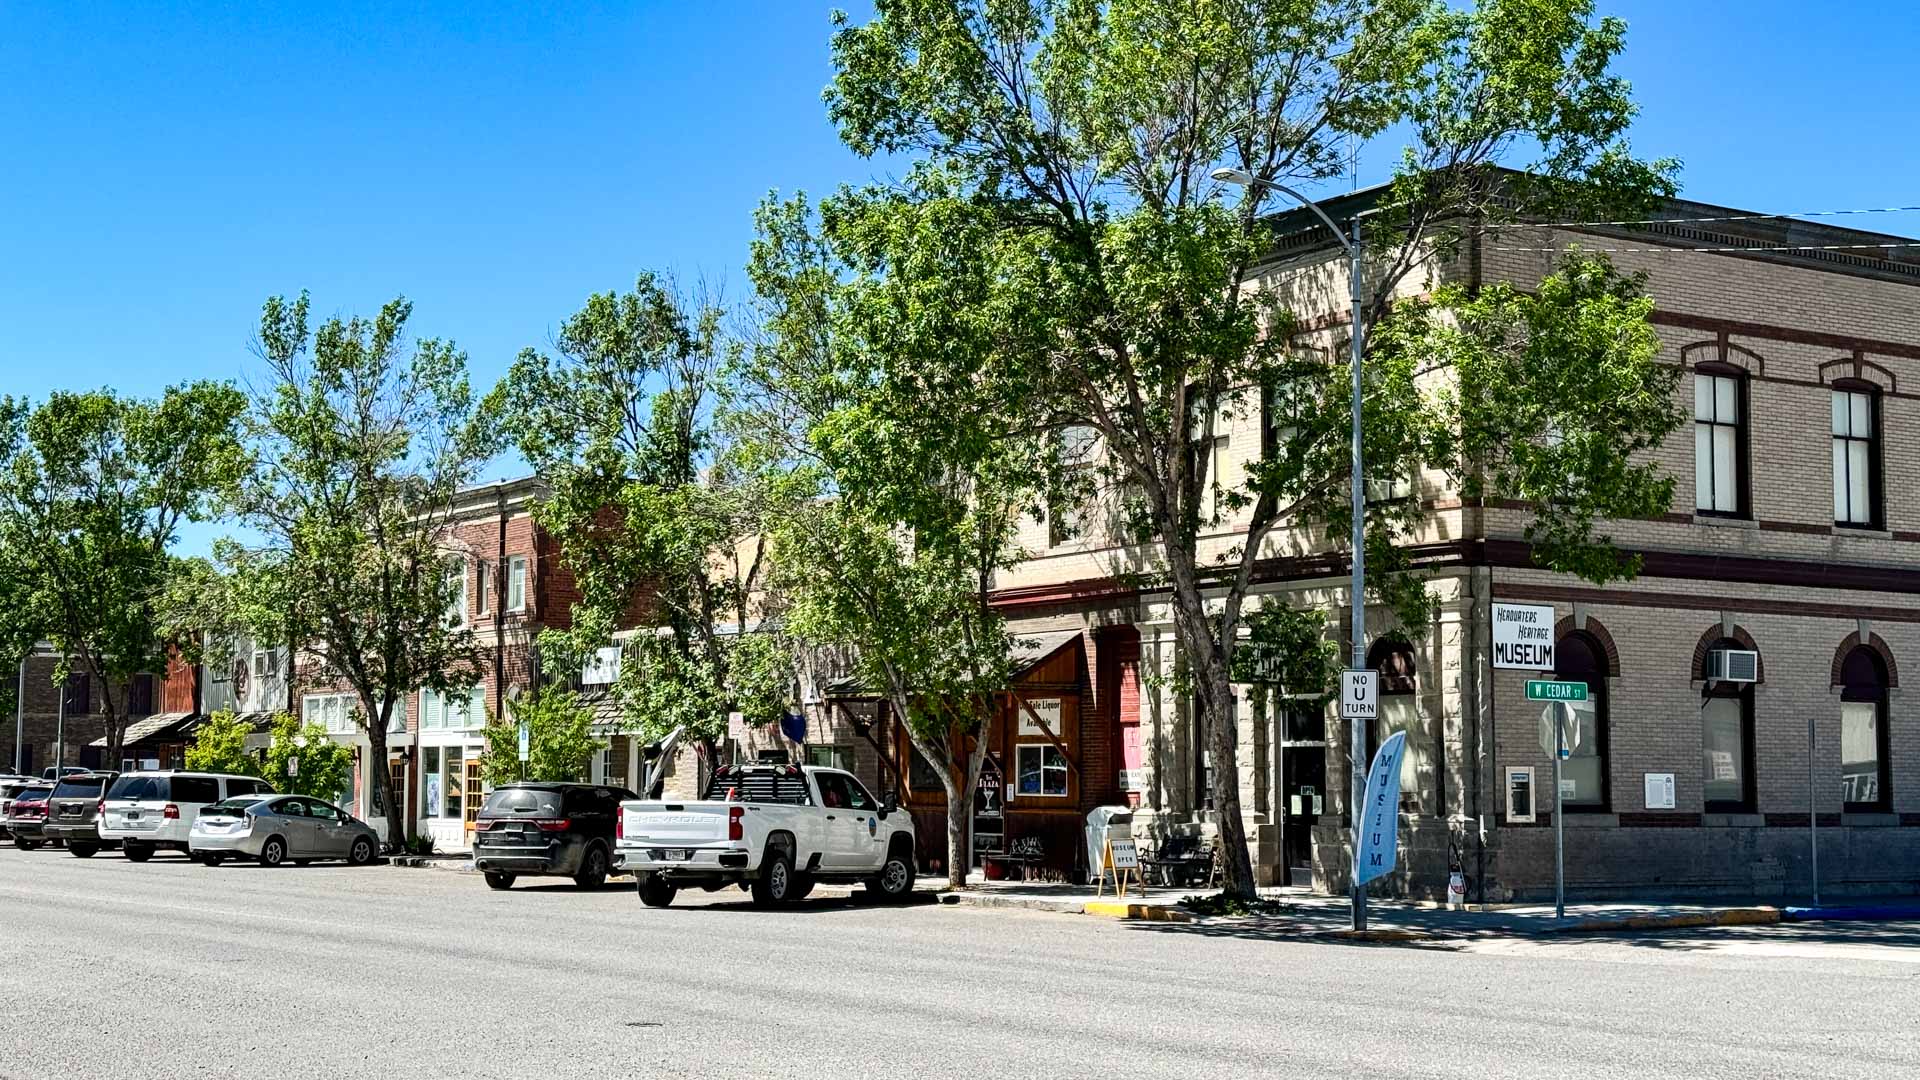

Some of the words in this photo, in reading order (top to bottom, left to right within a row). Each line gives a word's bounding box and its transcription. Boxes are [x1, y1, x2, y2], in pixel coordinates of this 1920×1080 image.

[1518, 624, 1549, 640] HERITAGE
[1495, 642, 1552, 666] MUSEUM
[1352, 675, 1367, 685] NO
[1354, 687, 1366, 701] U
[1535, 684, 1542, 697] W
[1546, 684, 1572, 698] CEDAR
[1574, 689, 1581, 699] ST
[1042, 700, 1060, 712] Liquor
[1345, 703, 1375, 713] TURN
[1370, 754, 1392, 866] MUSEUM
[629, 815, 721, 825] CHEVROLET
